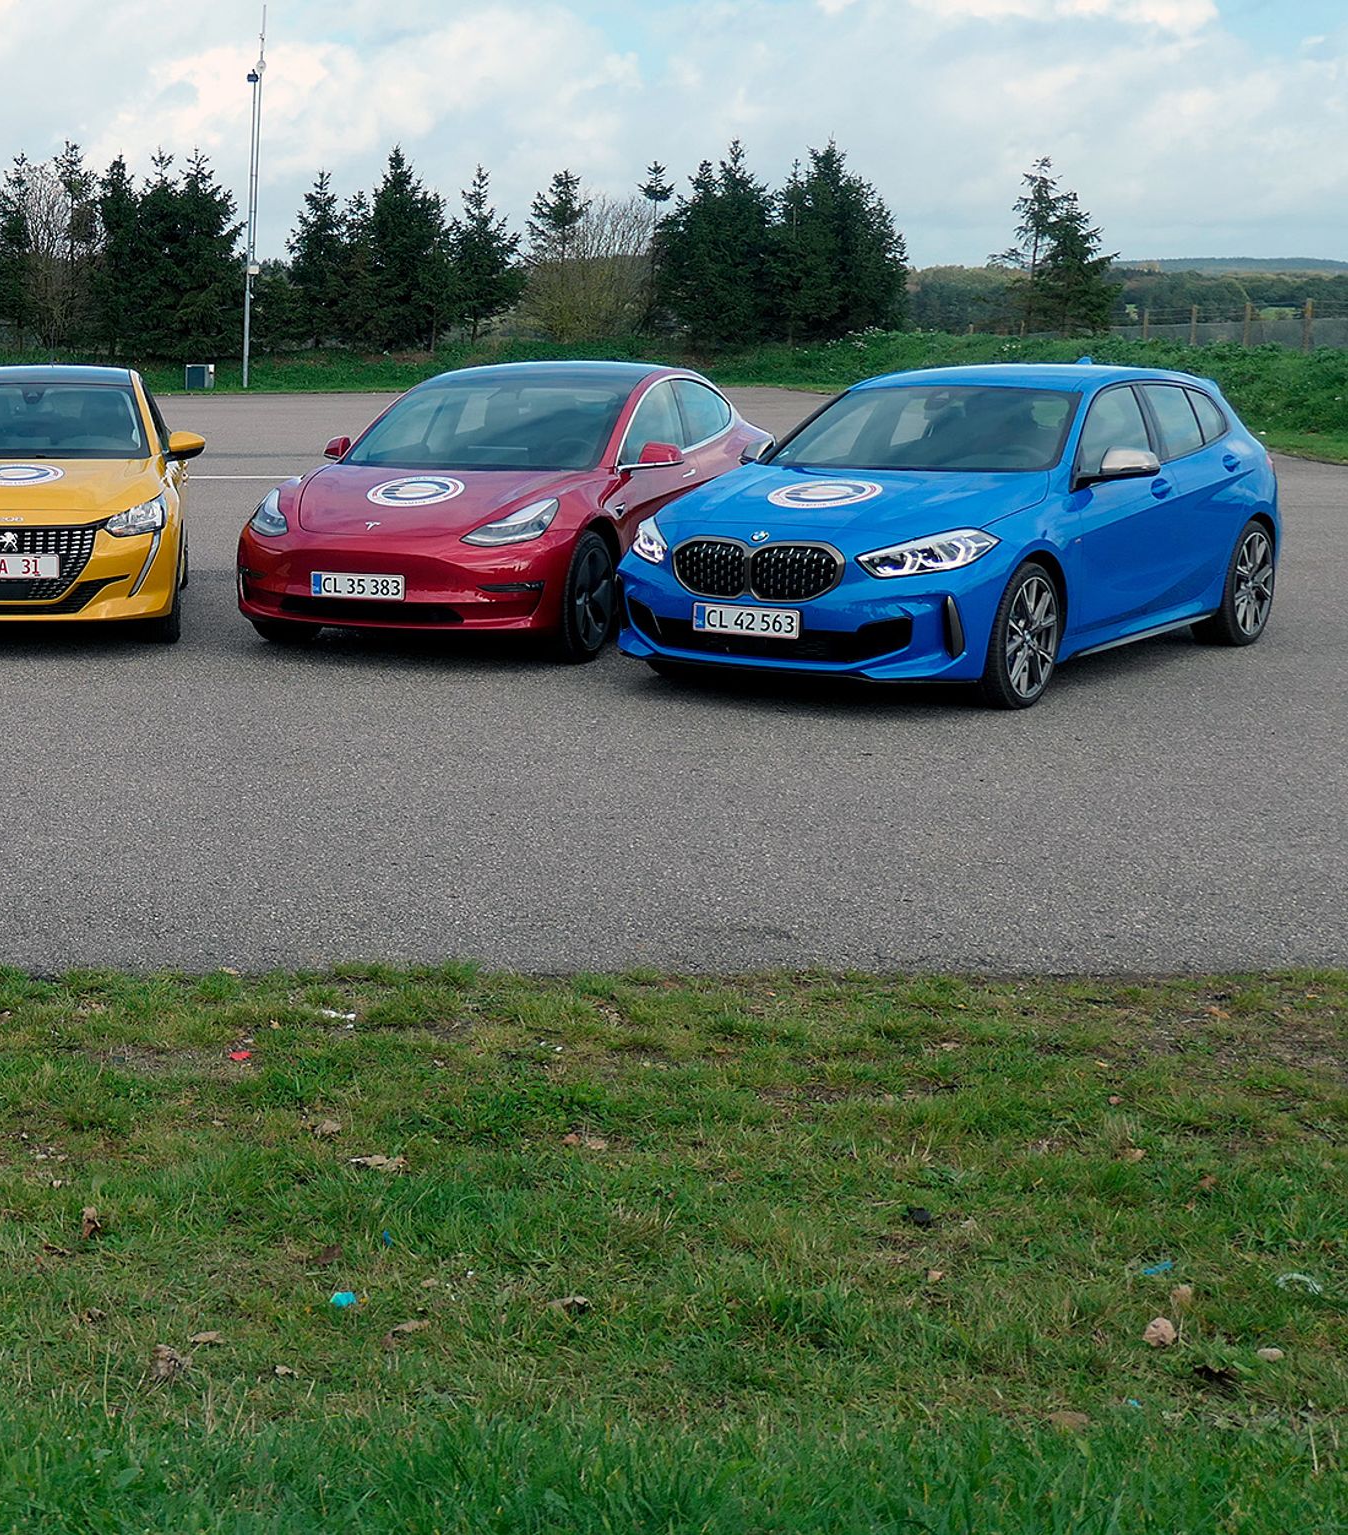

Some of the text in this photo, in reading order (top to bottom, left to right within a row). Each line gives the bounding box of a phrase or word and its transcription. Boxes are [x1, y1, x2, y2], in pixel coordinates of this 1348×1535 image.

[21, 558, 40, 575] 31
[323, 577, 401, 596] CL 35 383
[707, 609, 795, 634] CL 42 563
